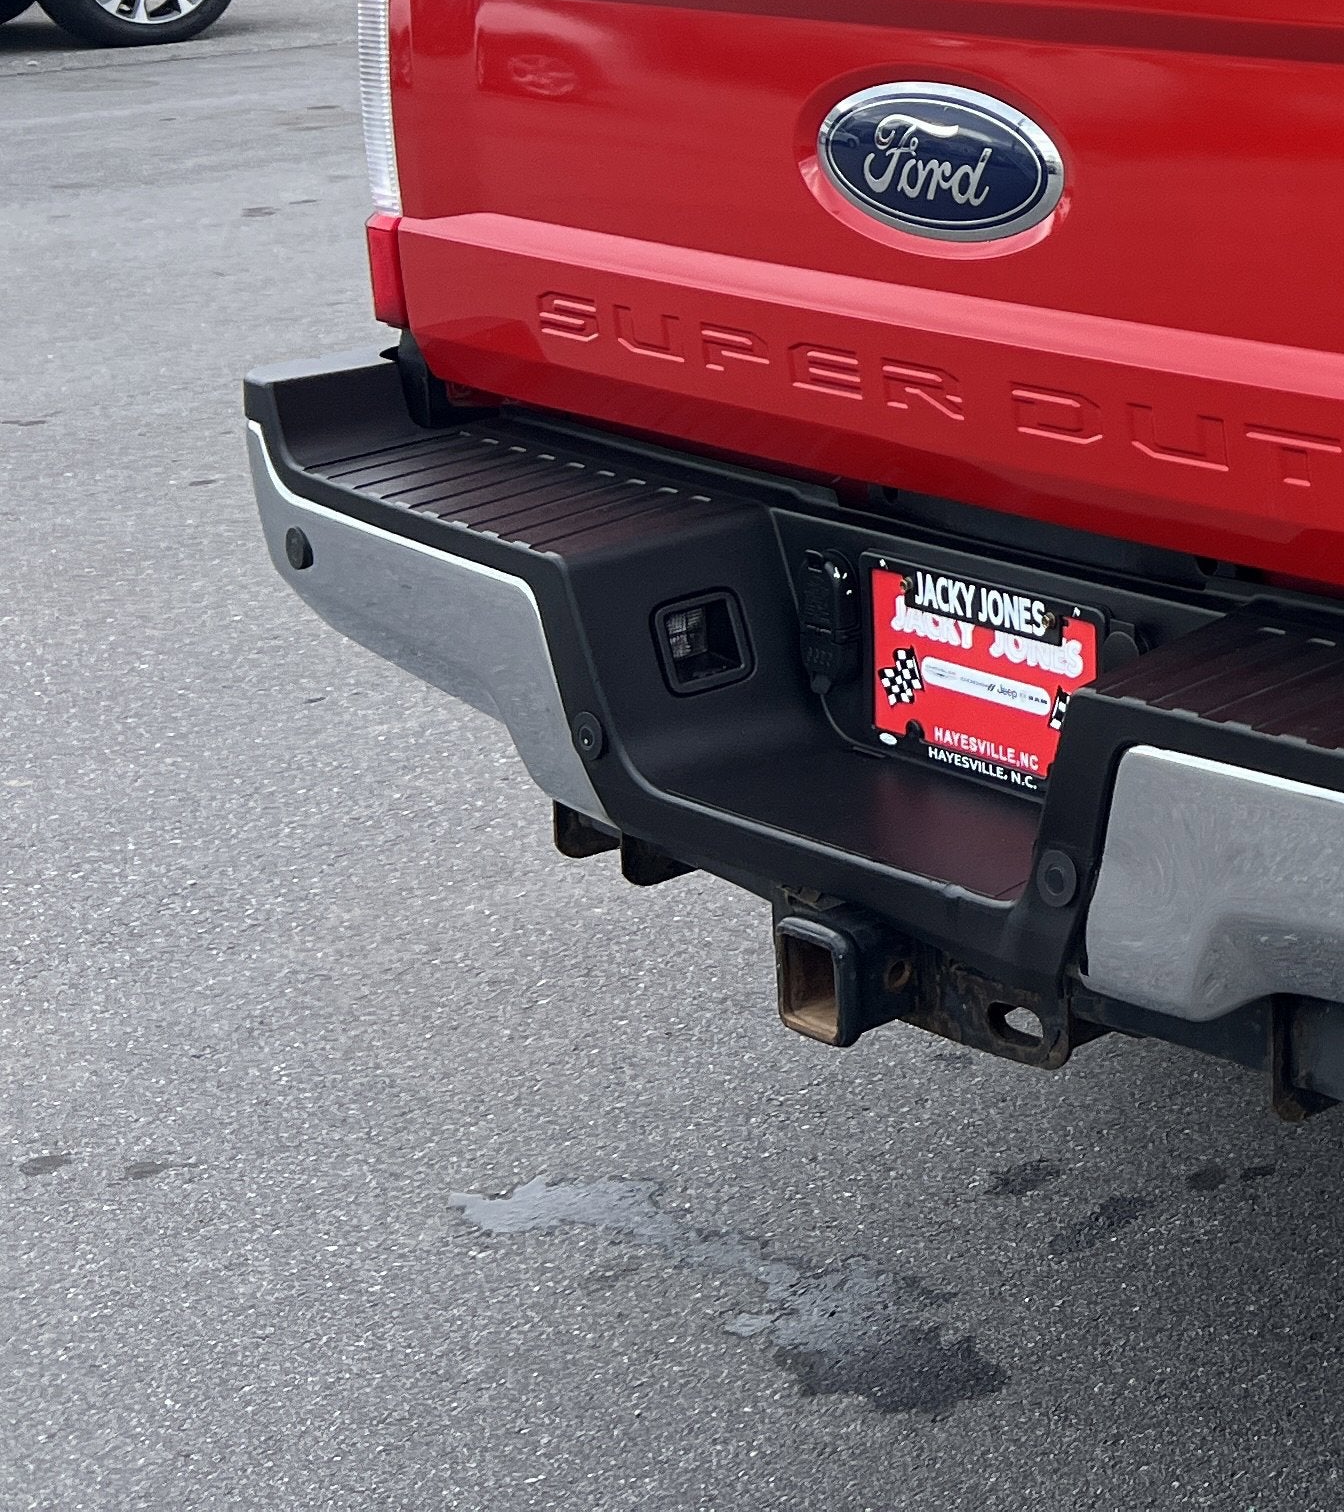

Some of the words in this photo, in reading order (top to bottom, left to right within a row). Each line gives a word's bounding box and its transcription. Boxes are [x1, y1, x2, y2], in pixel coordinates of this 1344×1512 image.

[863, 113, 993, 207] Ford
[537, 290, 966, 421] SUPER
[914, 571, 976, 618] JACKY
[978, 587, 1047, 637] JONES
[928, 746, 1008, 780] HAYESVILLE,
[1010, 766, 1038, 790] N.C.
